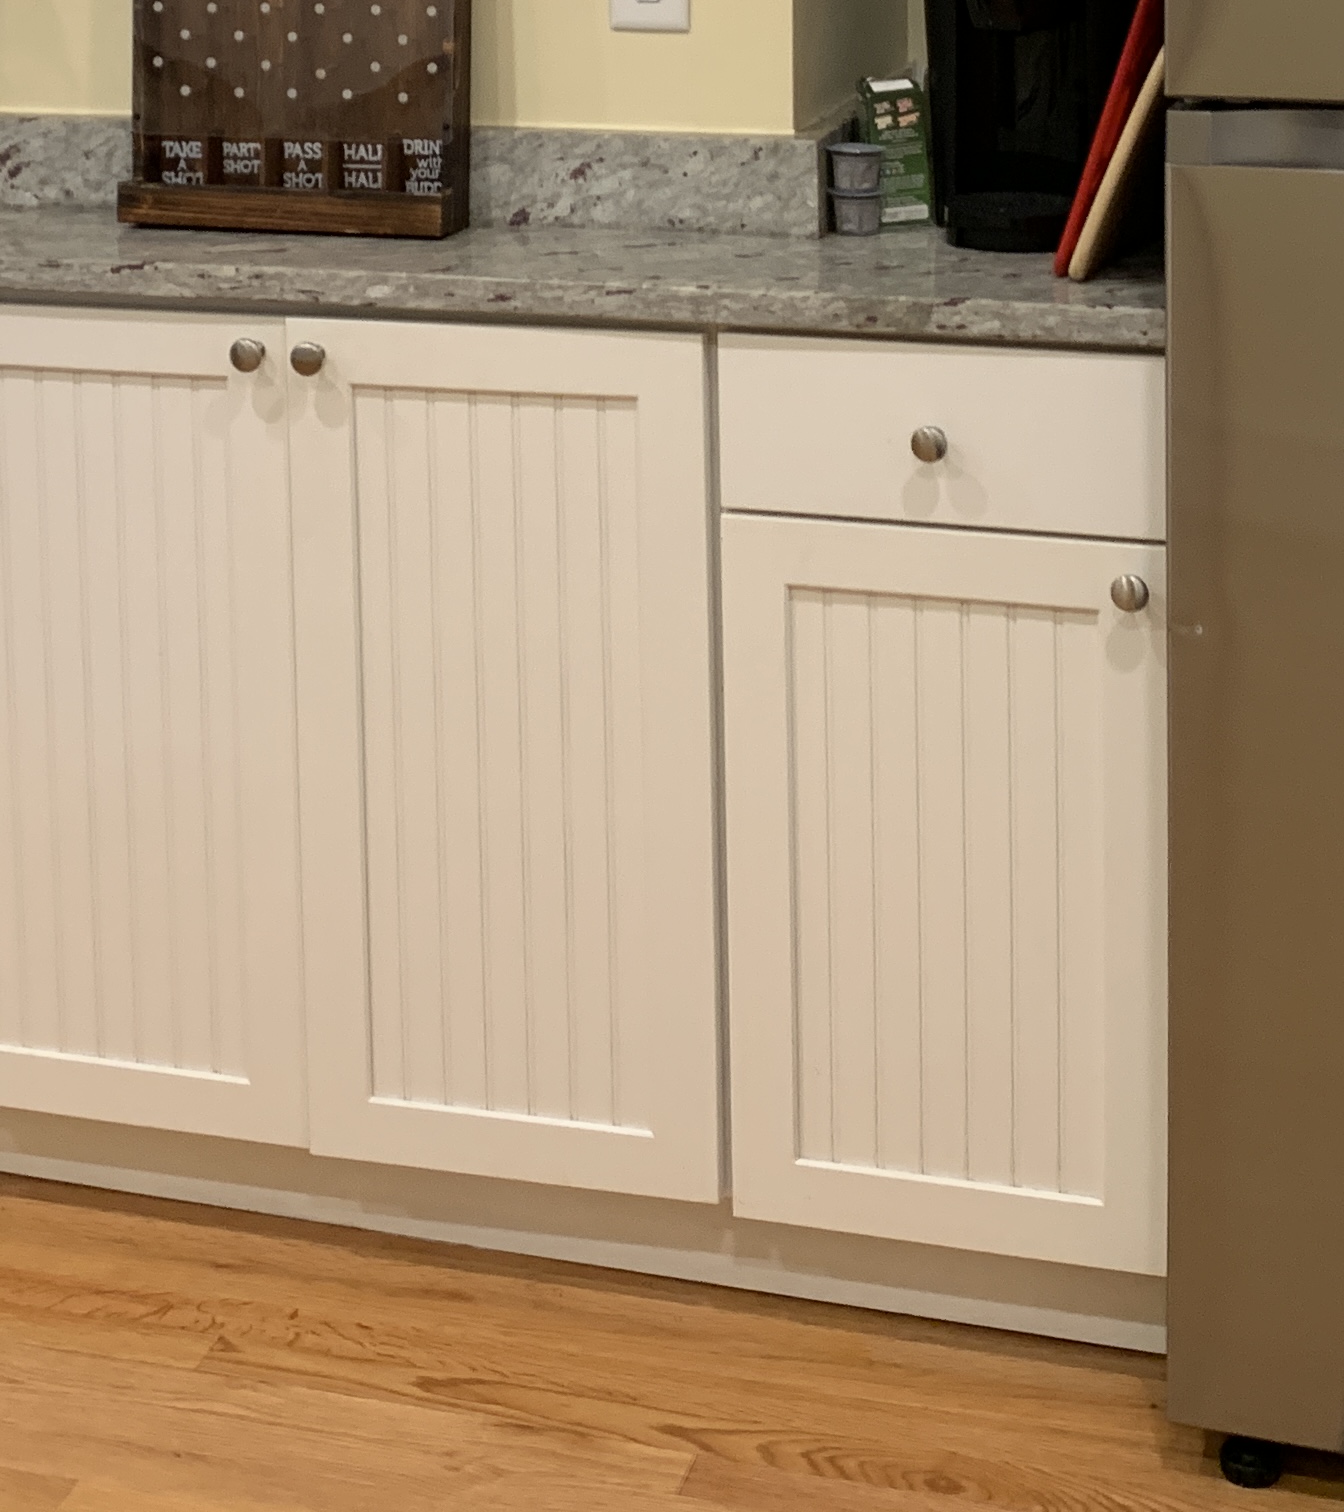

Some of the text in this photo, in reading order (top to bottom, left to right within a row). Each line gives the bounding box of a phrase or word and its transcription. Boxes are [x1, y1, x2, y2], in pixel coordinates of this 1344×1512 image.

[161, 141, 202, 158] TAKE
[283, 141, 322, 159] PASS
[177, 158, 186, 170] A
[222, 159, 261, 174] SHOT
[297, 159, 307, 171] A
